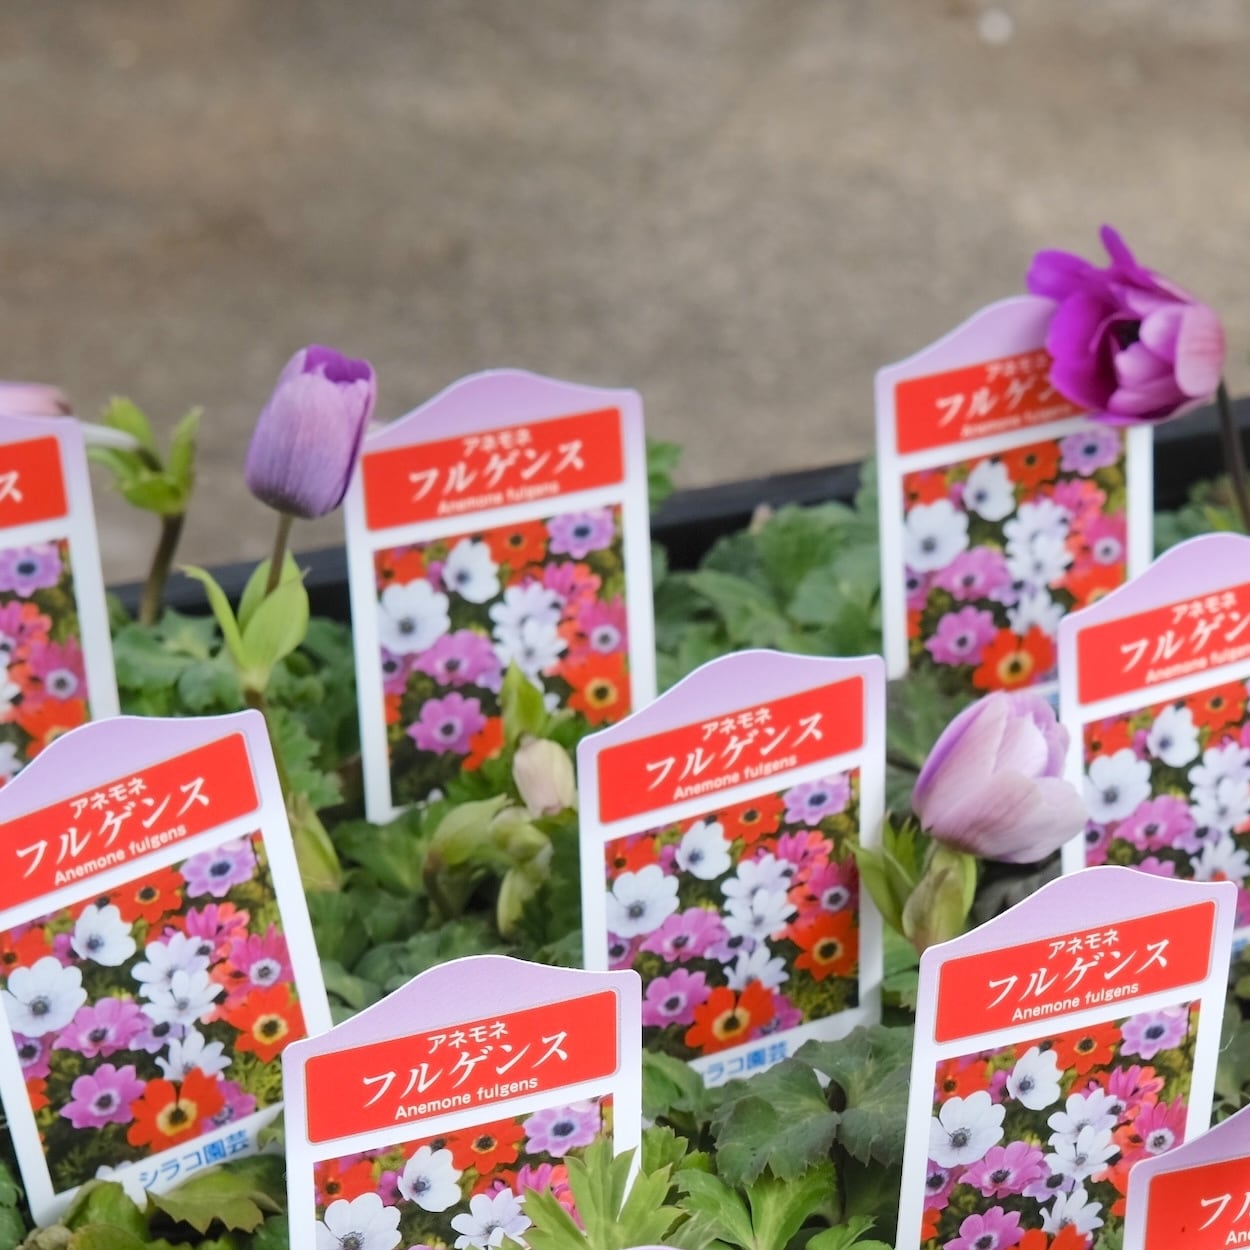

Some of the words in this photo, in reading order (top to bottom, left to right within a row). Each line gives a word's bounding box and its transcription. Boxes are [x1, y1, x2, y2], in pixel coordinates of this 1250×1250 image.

[409, 440, 583, 501] フルゲンス
[701, 706, 772, 741] アネモネ
[646, 712, 823, 791] フルゲンス
[69, 776, 147, 820] アネモネ
[673, 772, 740, 801] Anemone
[743, 755, 797, 780] fulgens
[15, 776, 210, 878] フルゲンス
[54, 849, 126, 886] Anemone
[128, 824, 188, 856] fulgens
[1048, 927, 1120, 960] アネモネ
[986, 938, 1170, 1010] フルゲンス
[1011, 996, 1081, 1023] Anemone
[1084, 982, 1140, 1005] fulgens
[426, 1020, 509, 1055] アネモネ
[362, 1030, 569, 1108] フルゲンス
[705, 1040, 788, 1082] ラコ園芸
[394, 1092, 472, 1121] Anemone
[476, 1077, 539, 1102] fulgens
[138, 1128, 250, 1190] シラコ園芸
